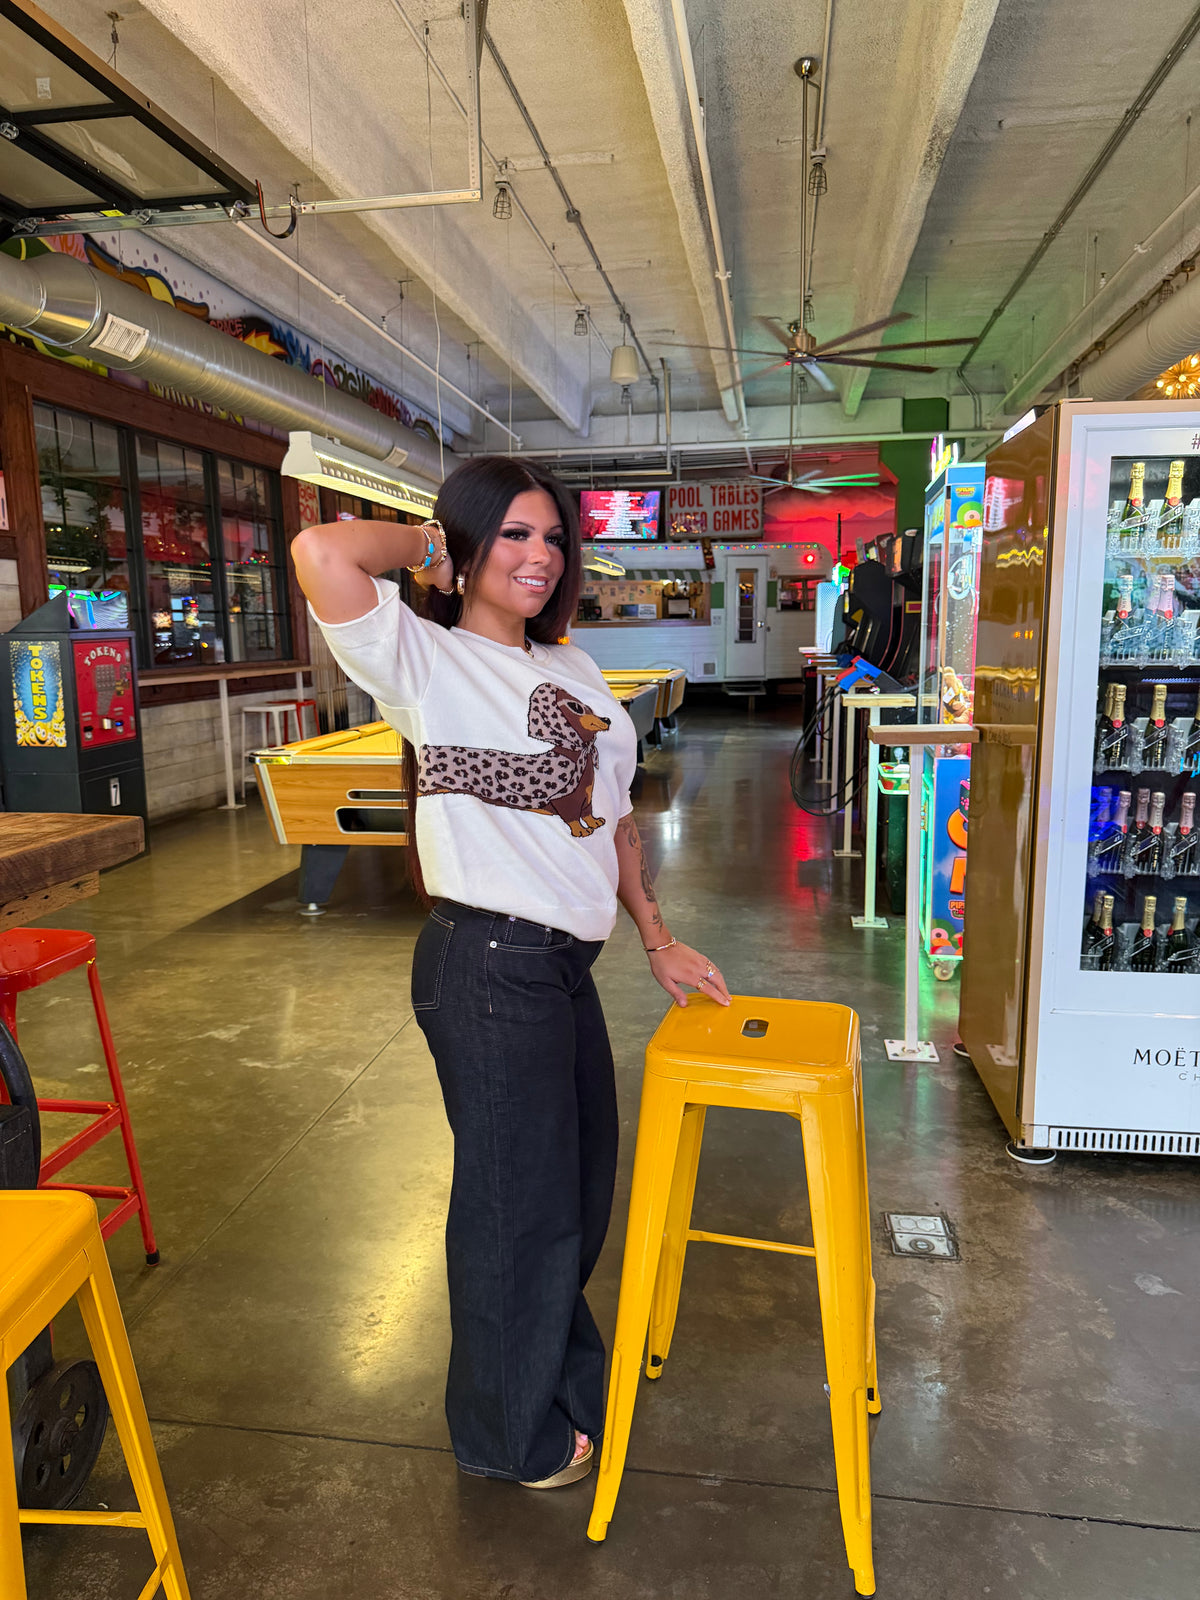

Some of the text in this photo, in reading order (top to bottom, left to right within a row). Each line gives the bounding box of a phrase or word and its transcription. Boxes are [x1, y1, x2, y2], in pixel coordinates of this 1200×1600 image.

[669, 485, 759, 508] POOL TABLES
[713, 508, 759, 533] GAMES
[84, 646, 122, 666] TOKENS
[28, 645, 47, 720] TOKENS
